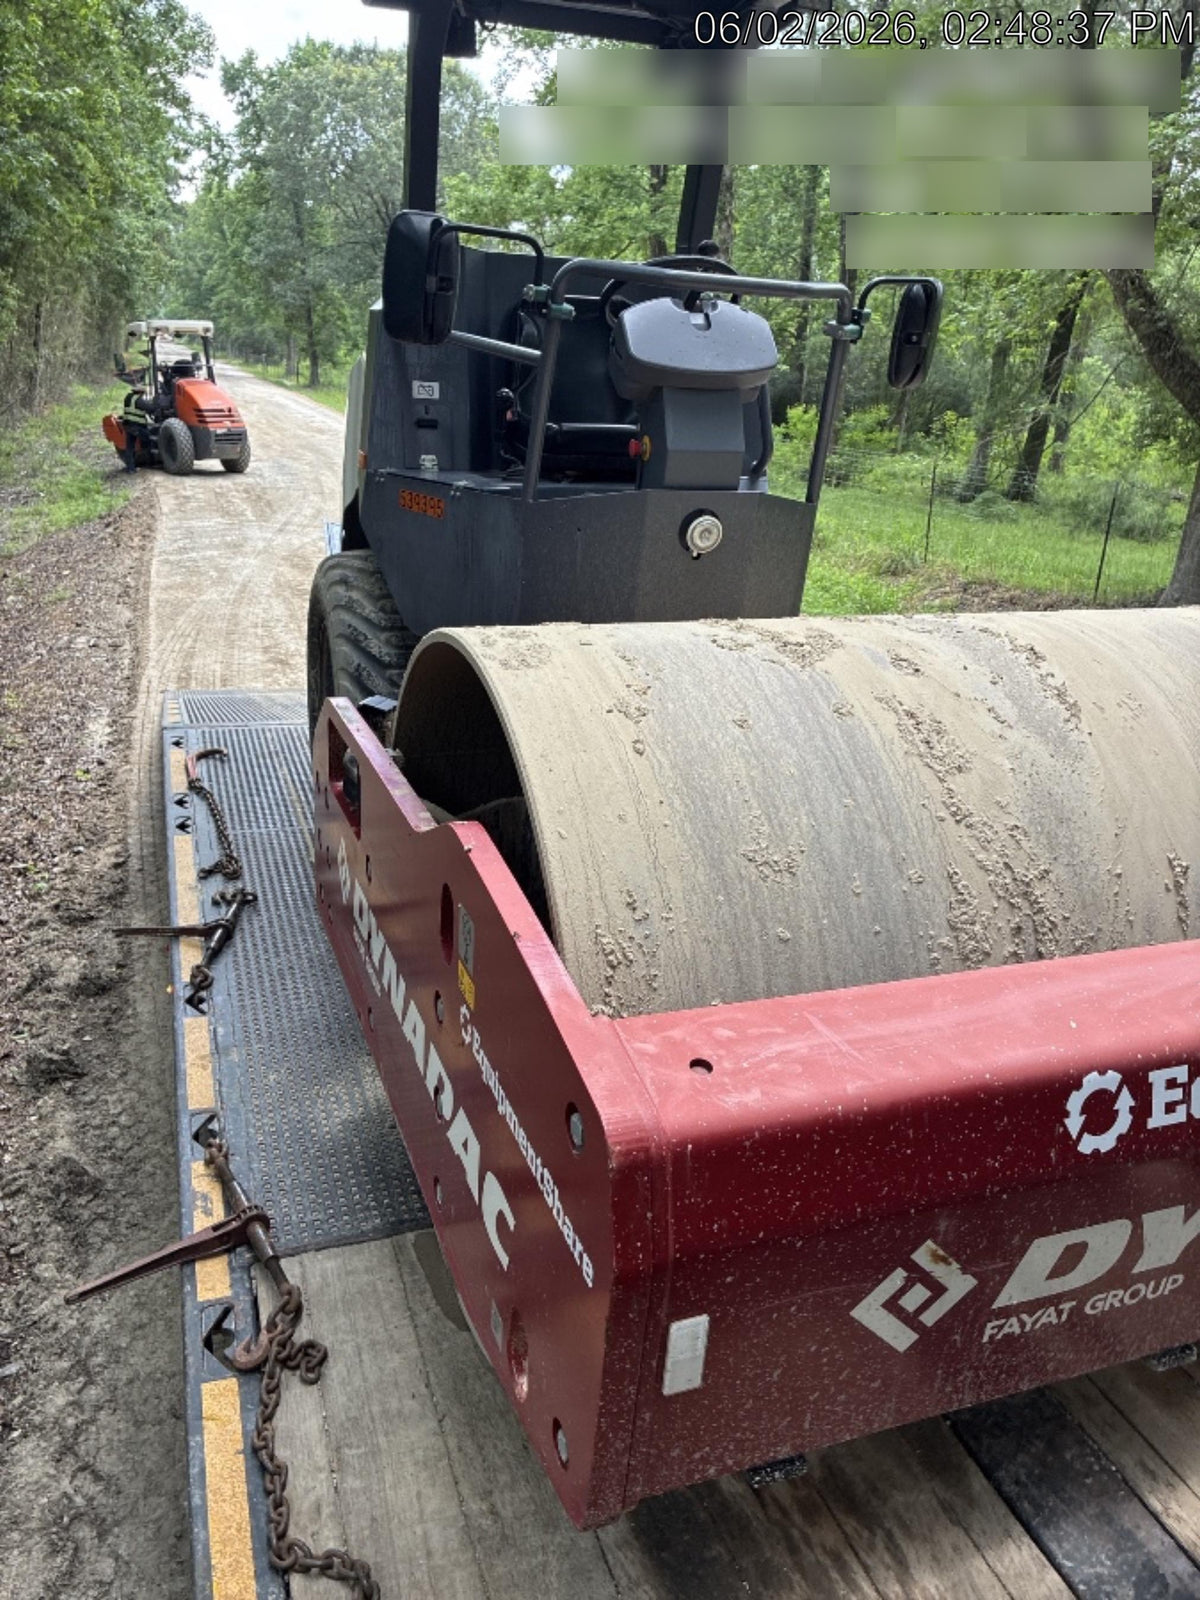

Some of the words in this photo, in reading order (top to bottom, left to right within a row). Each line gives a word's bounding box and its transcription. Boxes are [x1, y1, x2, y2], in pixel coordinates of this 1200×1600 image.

[353, 878, 517, 1271] DYNAPAC
[472, 1026, 594, 1288] EquipmentShare
[1147, 1064, 1200, 1129] E
[982, 1302, 1076, 1342] FAYAT
[1084, 1274, 1184, 1314] GROUP
